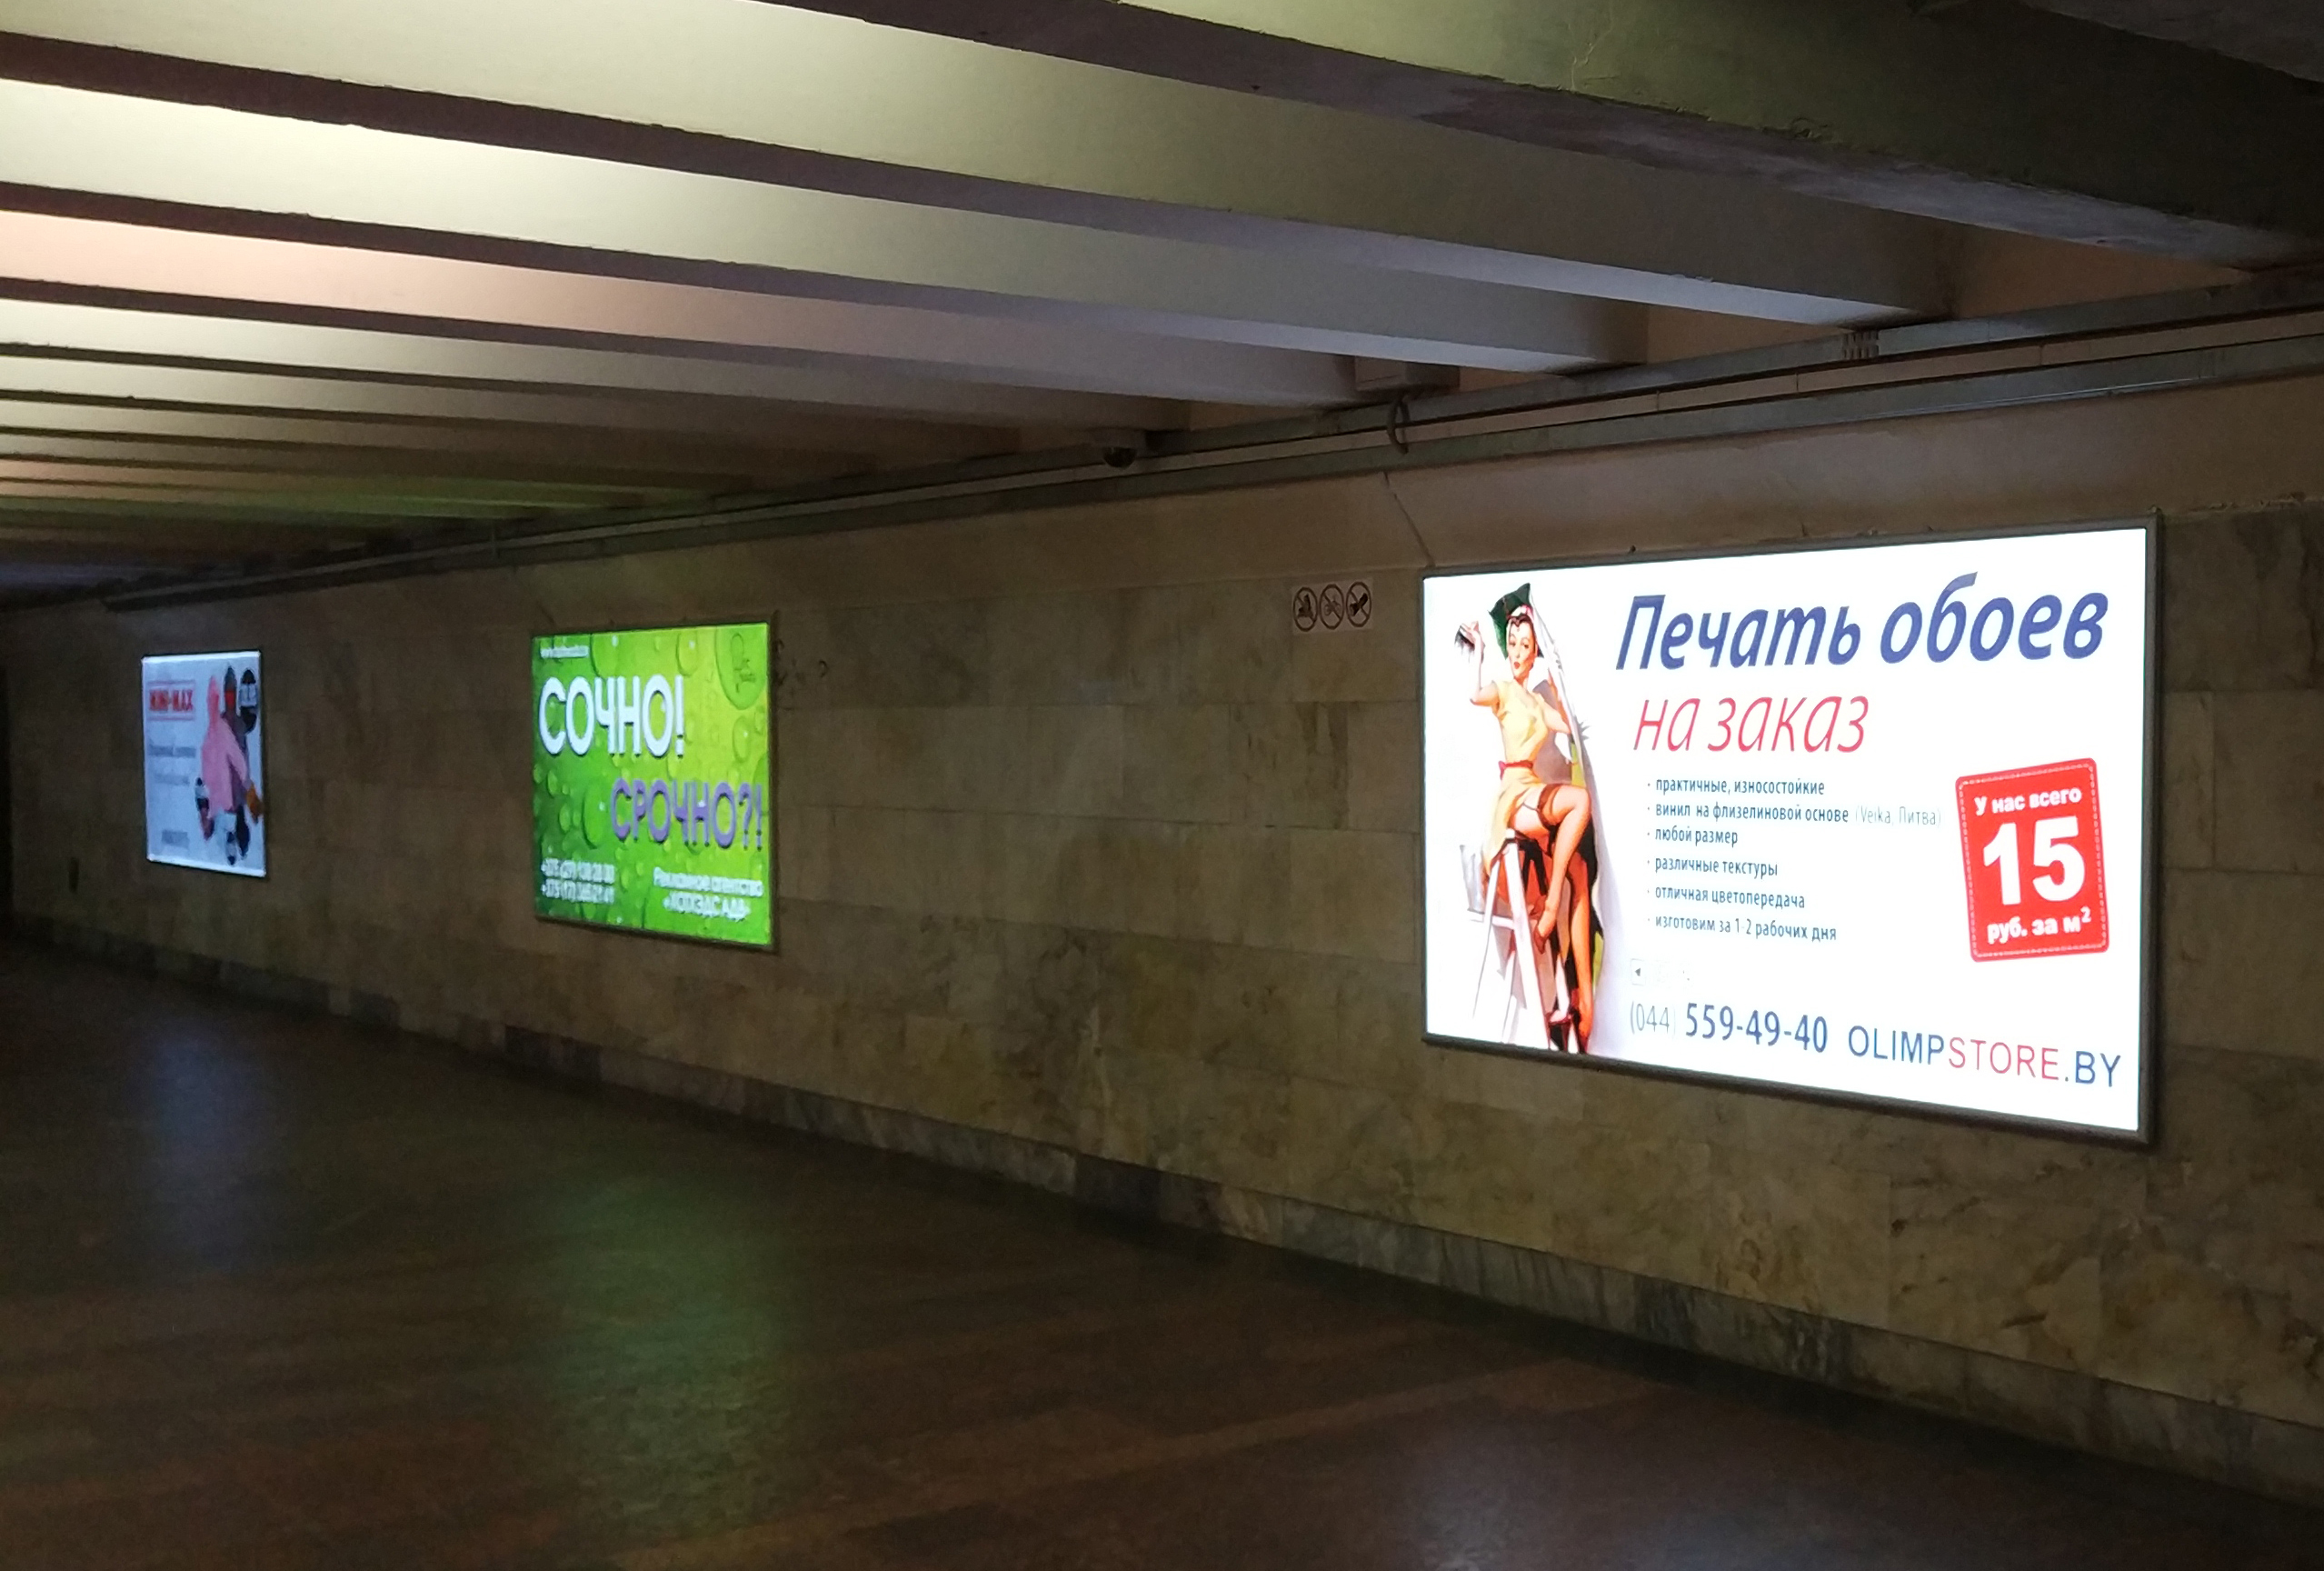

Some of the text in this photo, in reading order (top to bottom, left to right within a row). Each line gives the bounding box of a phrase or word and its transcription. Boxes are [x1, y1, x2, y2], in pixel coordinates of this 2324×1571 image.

[1615, 571, 2109, 670] Печать обоев
[539, 674, 685, 758] СОЧНО!
[1633, 695, 1870, 754] на заказ
[1655, 777, 1826, 796] практичные, износостойкие
[1992, 796, 2025, 813] нас
[2030, 787, 2081, 808] всего
[612, 778, 763, 851] СРОЧНО?!
[1655, 803, 1691, 817] винил
[1695, 804, 1711, 819] на
[1712, 801, 1803, 823] флизелиновой
[1805, 807, 1850, 823] основе
[1654, 825, 1739, 847] любой размер
[1654, 856, 1779, 879] различные текстуры
[1982, 816, 2086, 906] 15
[1654, 886, 1806, 910] отличная цветопередача
[1654, 915, 1716, 933] изготовим
[1718, 920, 1731, 935] за
[1755, 920, 1808, 939] рабочих
[1811, 926, 1838, 943] дня
[1987, 916, 2028, 944] руб.
[2031, 918, 2058, 935] за
[1685, 1002, 1828, 1054] 559-49-40
[1848, 1025, 2122, 1088] OLIMPSTORE.BY
